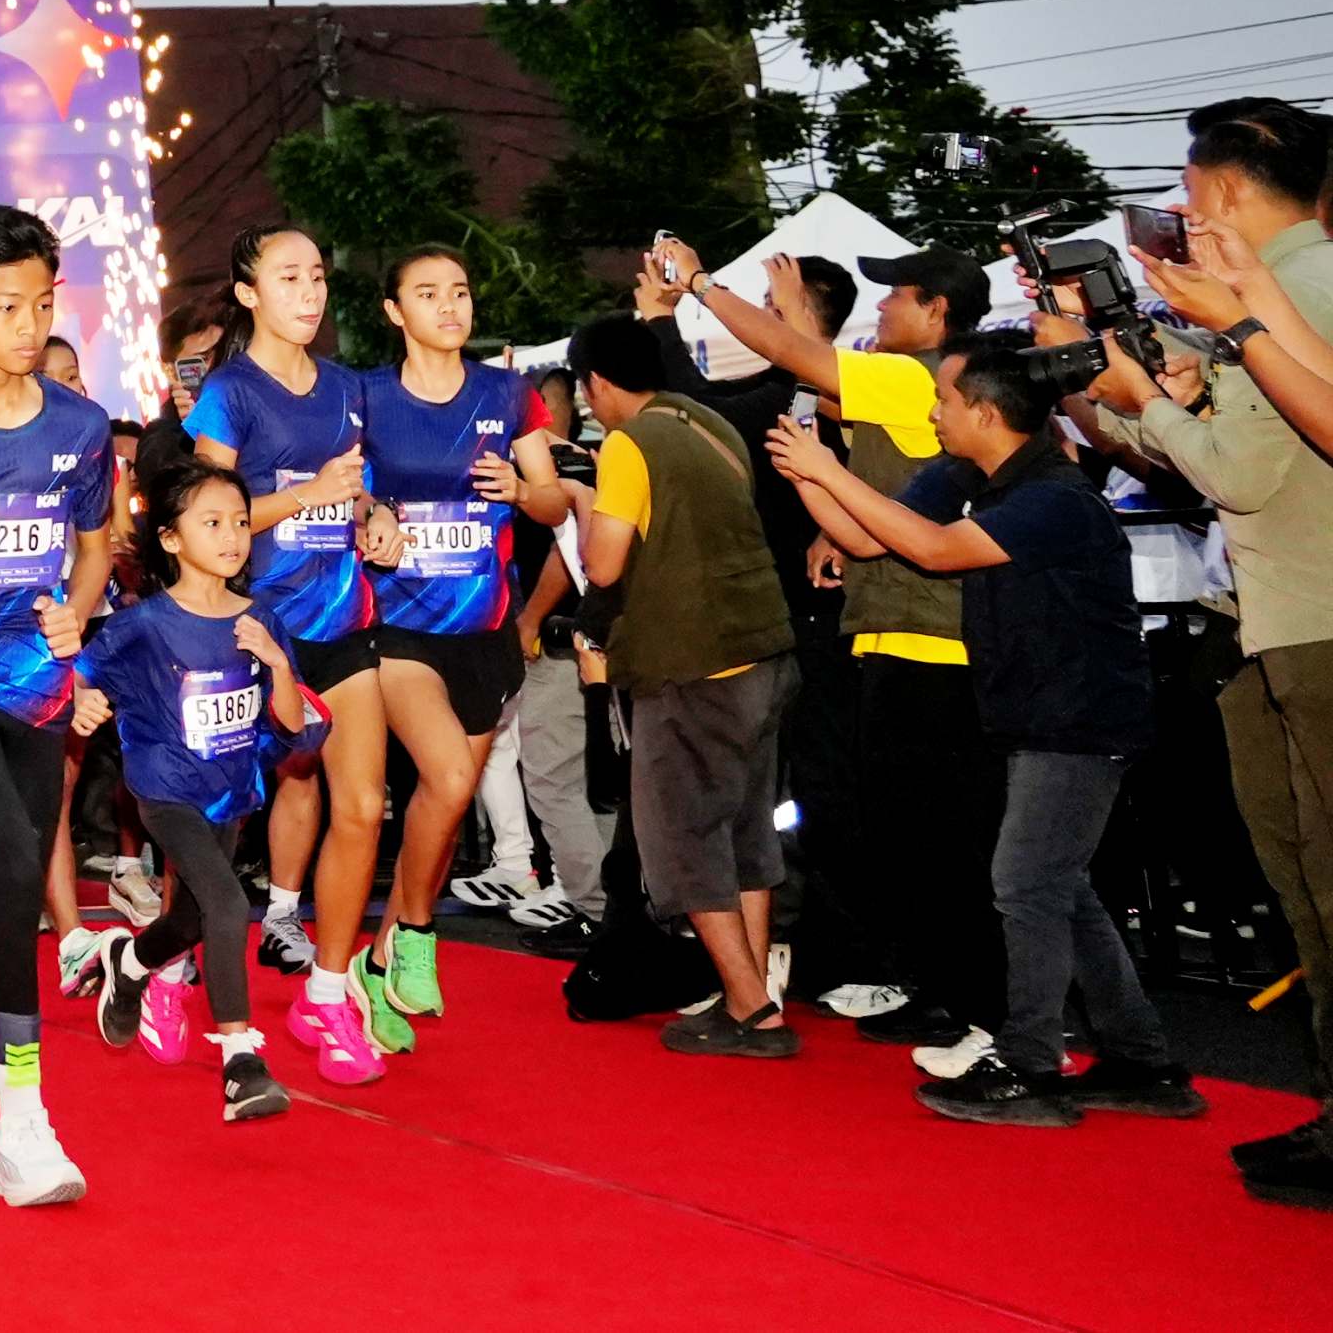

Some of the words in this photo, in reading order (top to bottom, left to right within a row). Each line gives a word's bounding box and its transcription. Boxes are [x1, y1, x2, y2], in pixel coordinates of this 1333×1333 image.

[476, 419, 504, 435] KAI
[36, 494, 60, 509] KAI
[408, 526, 471, 548] 51400
[196, 690, 253, 726] 51867
